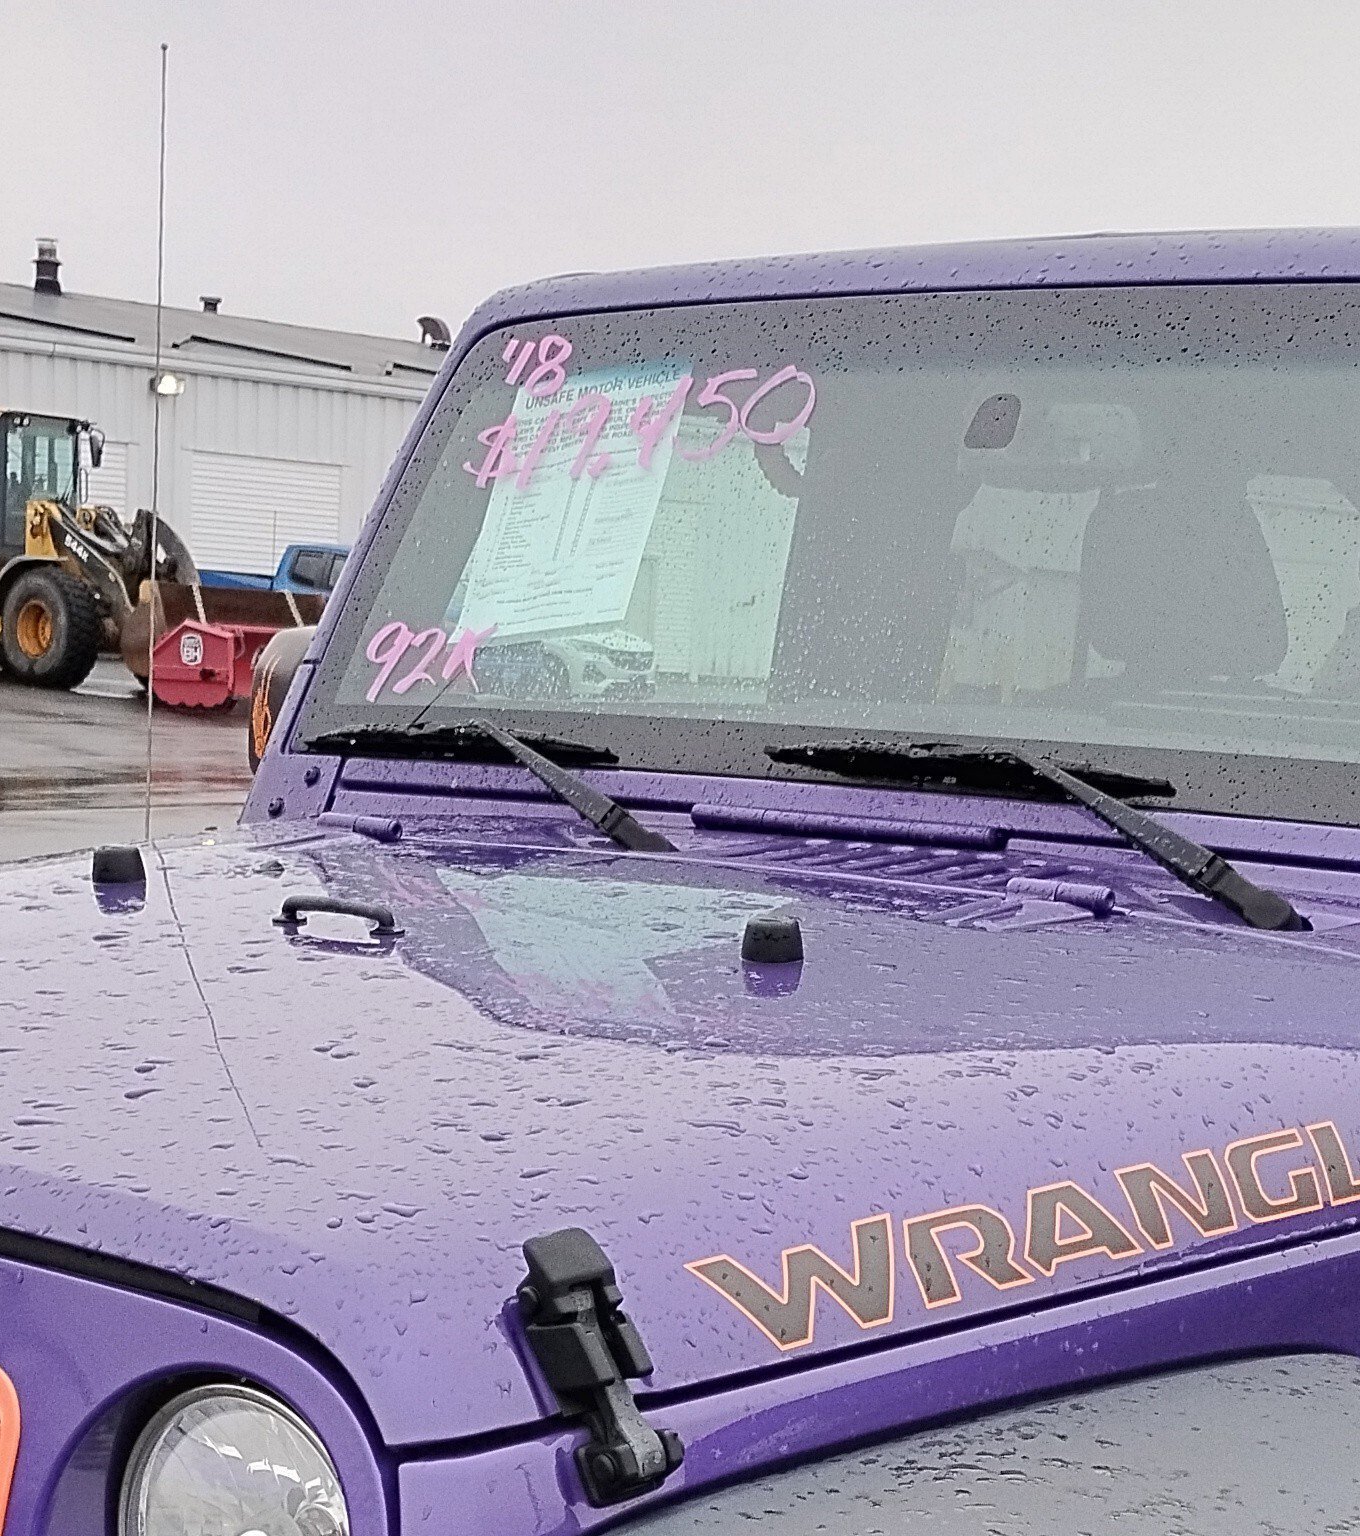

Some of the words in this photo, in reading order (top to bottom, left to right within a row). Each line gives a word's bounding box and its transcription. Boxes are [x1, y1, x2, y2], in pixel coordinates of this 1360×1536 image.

[526, 389, 574, 410] UNSAFE
[579, 377, 625, 400] MOTOR
[628, 370, 680, 390] VEHICLE
